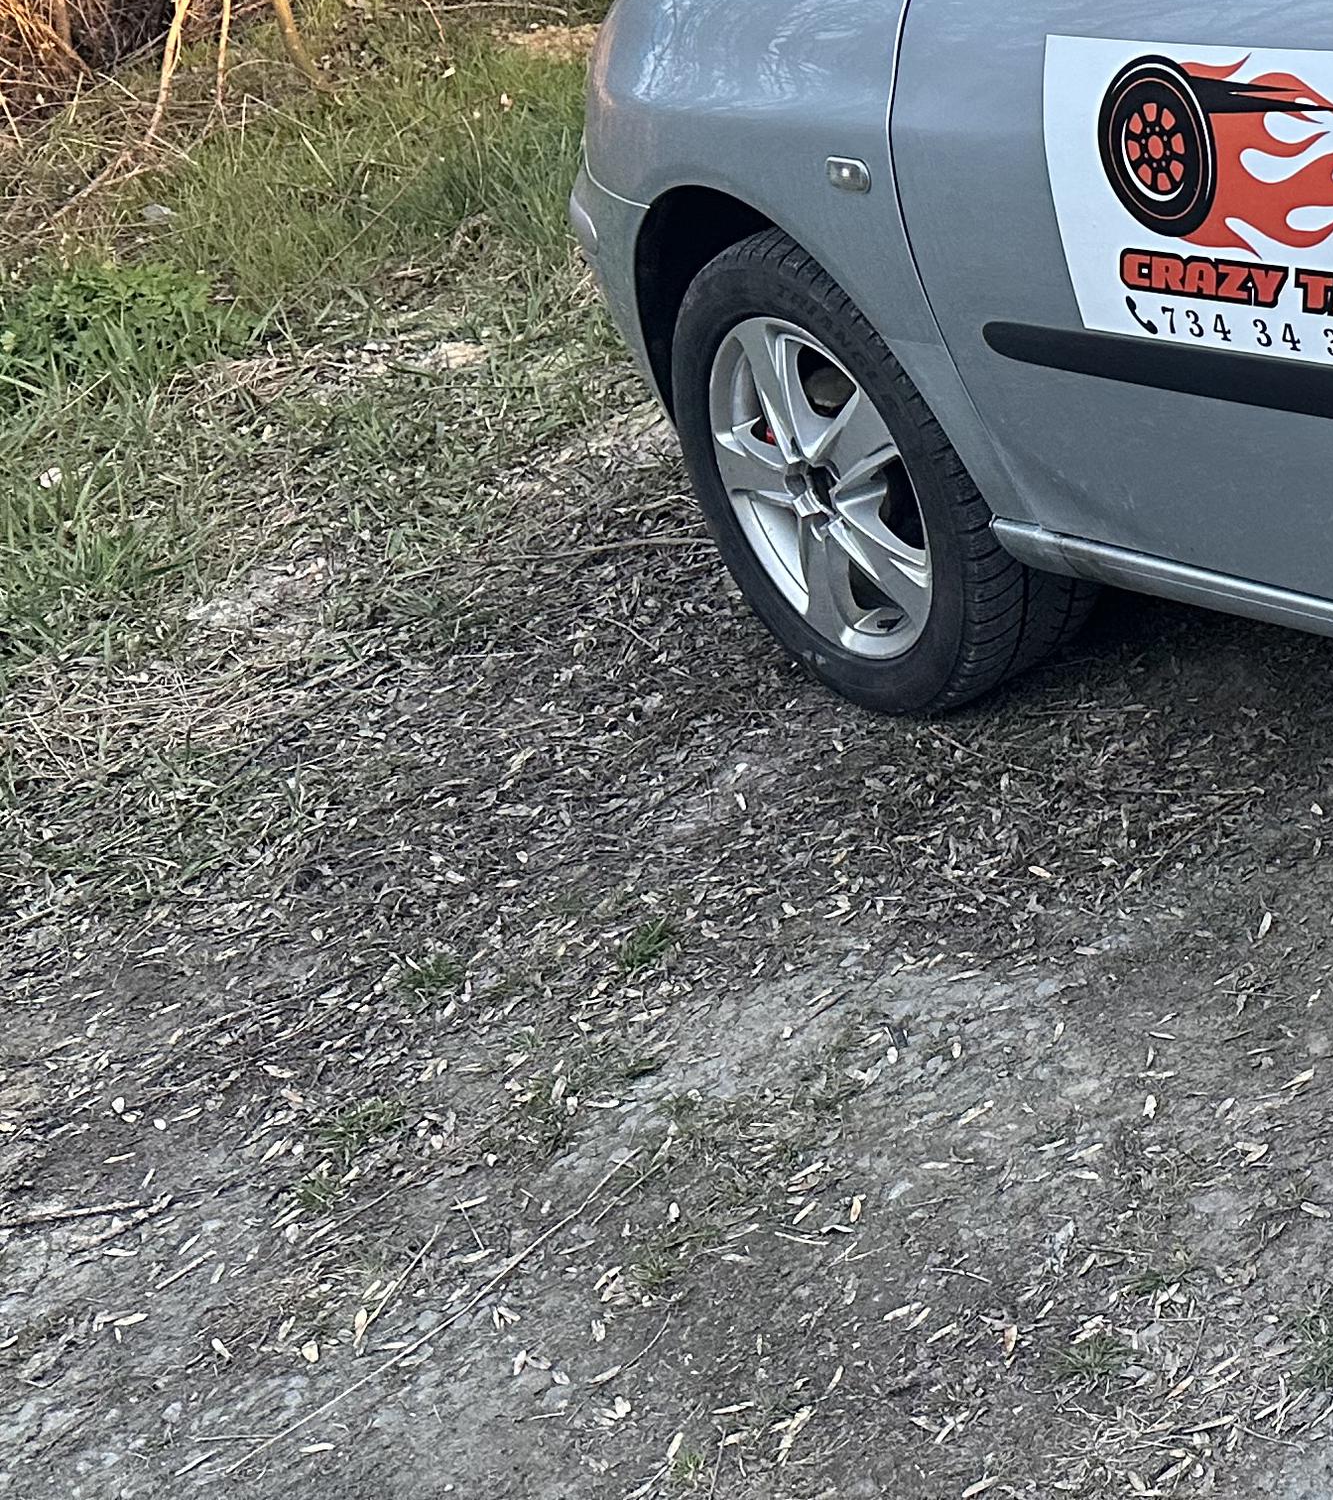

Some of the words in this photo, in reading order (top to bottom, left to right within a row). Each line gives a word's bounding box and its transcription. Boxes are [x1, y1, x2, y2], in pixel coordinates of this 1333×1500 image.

[1120, 248, 1289, 309] CRAZY
[1161, 305, 1232, 343] 734
[1252, 318, 1302, 352] 34
